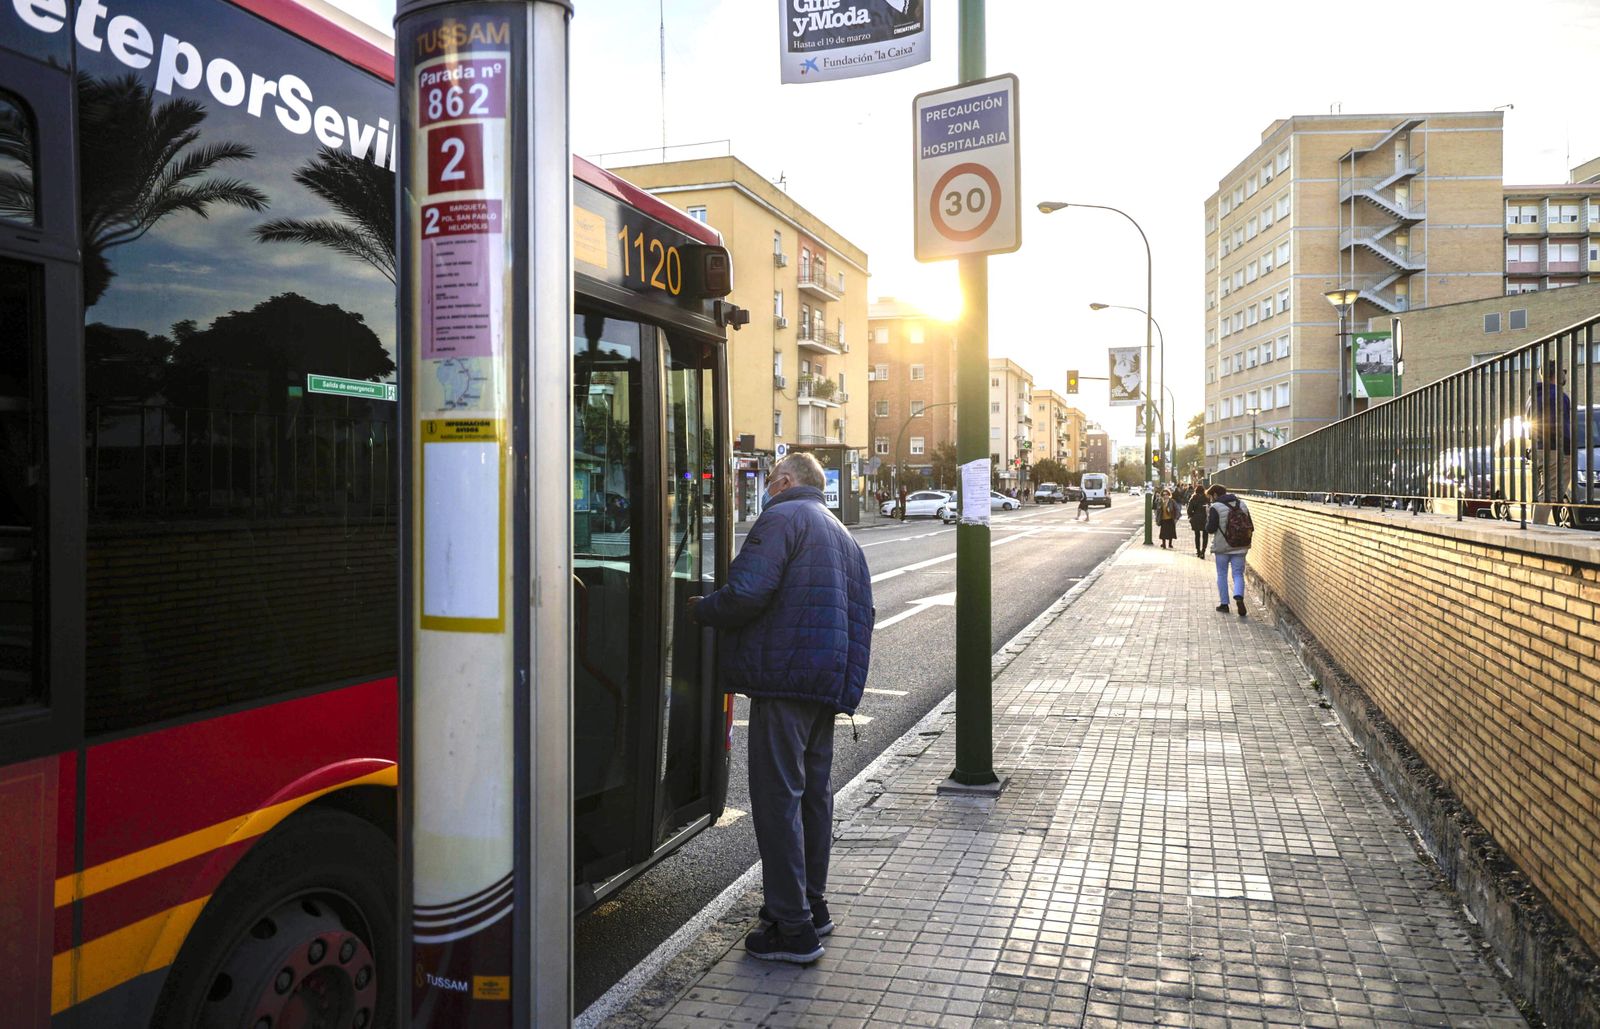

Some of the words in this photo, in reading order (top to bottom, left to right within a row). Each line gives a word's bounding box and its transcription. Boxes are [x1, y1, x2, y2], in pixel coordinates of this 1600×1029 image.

[417, 22, 510, 56] TUSSAM
[793, 39, 816, 49] Hasta
[817, 37, 824, 47] el
[825, 37, 835, 46] 19
[836, 35, 846, 44] de
[847, 33, 871, 42] marzo
[823, 53, 873, 68] Fundación
[420, 64, 475, 88] Parada
[427, 82, 490, 120] 862
[926, 96, 1003, 122] PRECAUCIÓN
[947, 119, 981, 135] ZONA
[923, 131, 1007, 157] HOSPITALARIA
[440, 137, 466, 183] 2
[945, 187, 986, 216] 30
[424, 207, 440, 236] 2
[472, 212, 497, 220] PABLO
[618, 224, 682, 296] 1120
[322, 380, 339, 389] Salida
[346, 384, 375, 393] emergencia
[426, 974, 468, 992] TUSSAM
